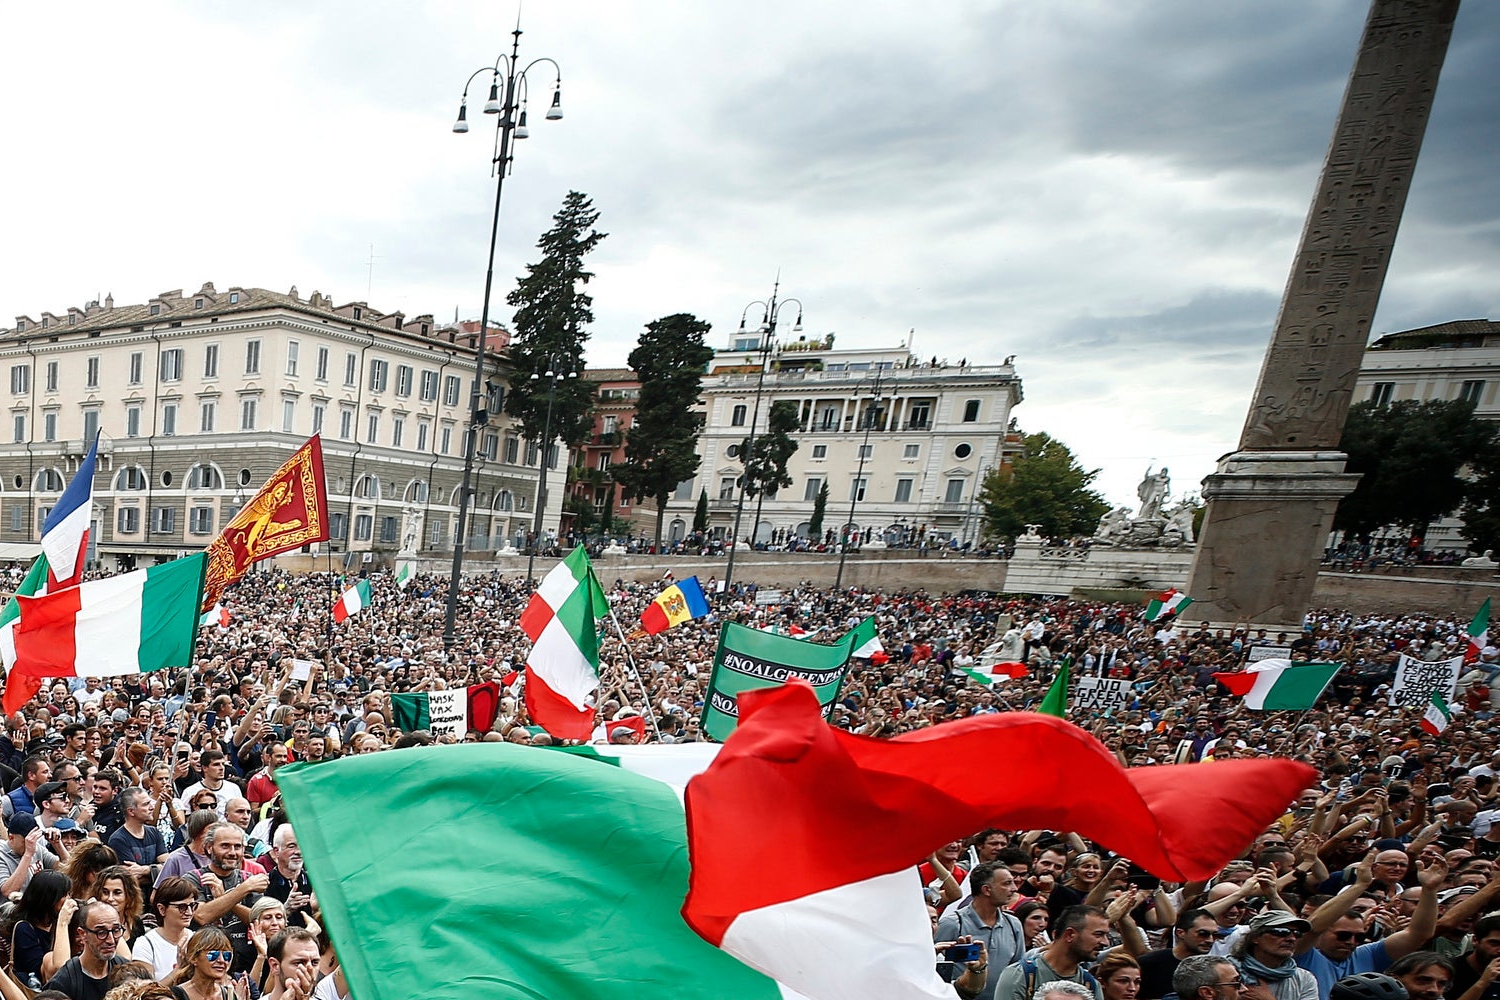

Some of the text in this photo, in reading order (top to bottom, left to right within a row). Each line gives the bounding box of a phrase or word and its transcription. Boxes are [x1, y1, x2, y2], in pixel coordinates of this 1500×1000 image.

[1096, 679, 1121, 691] NO
[429, 694, 454, 704] MASK
[1077, 687, 1129, 702] GREEN
[430, 705, 452, 714] VAX
[1079, 697, 1121, 710] PASS
